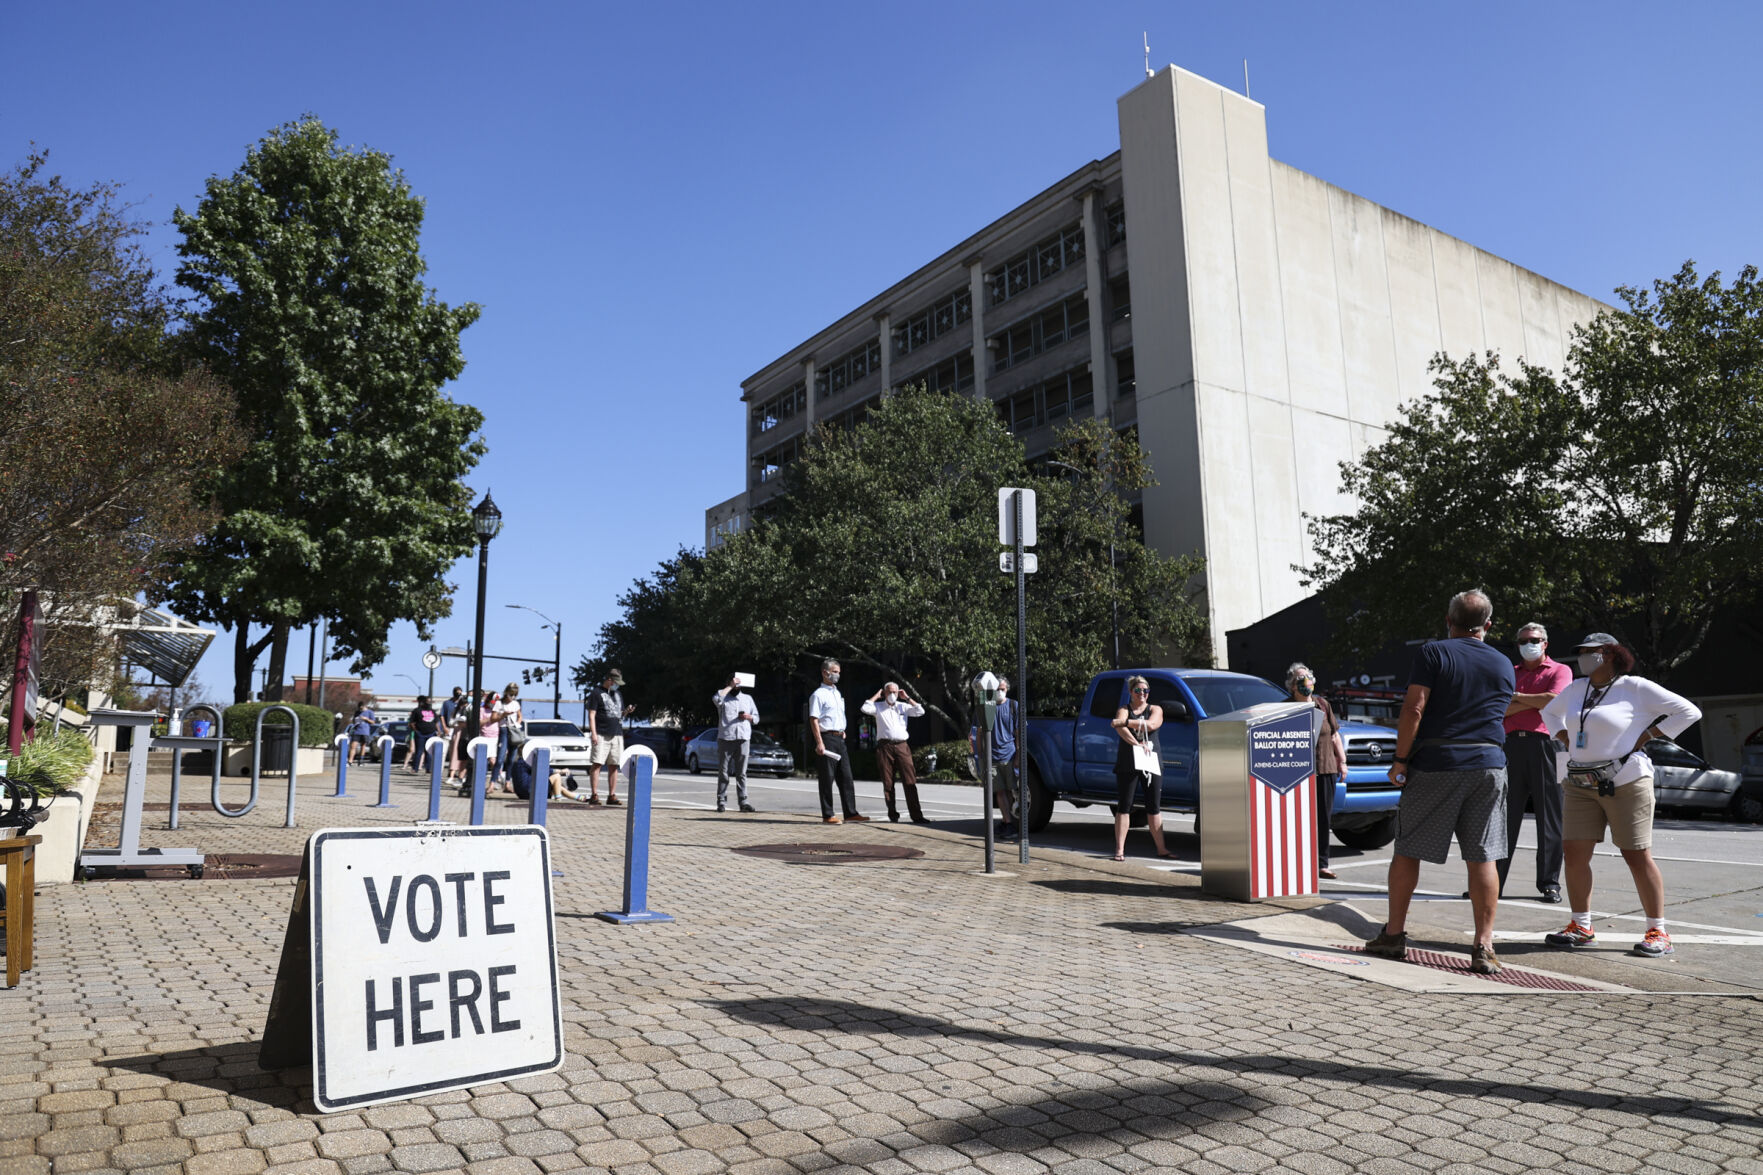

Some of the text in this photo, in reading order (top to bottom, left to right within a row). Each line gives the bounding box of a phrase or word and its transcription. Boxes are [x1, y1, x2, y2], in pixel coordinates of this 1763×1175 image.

[1253, 731, 1310, 739] OFFICIAL ABSENTEE
[1254, 741, 1277, 749] BALLOT
[1277, 741, 1295, 749] DROP
[363, 870, 516, 944] VOTE
[365, 964, 521, 1051] HERE
